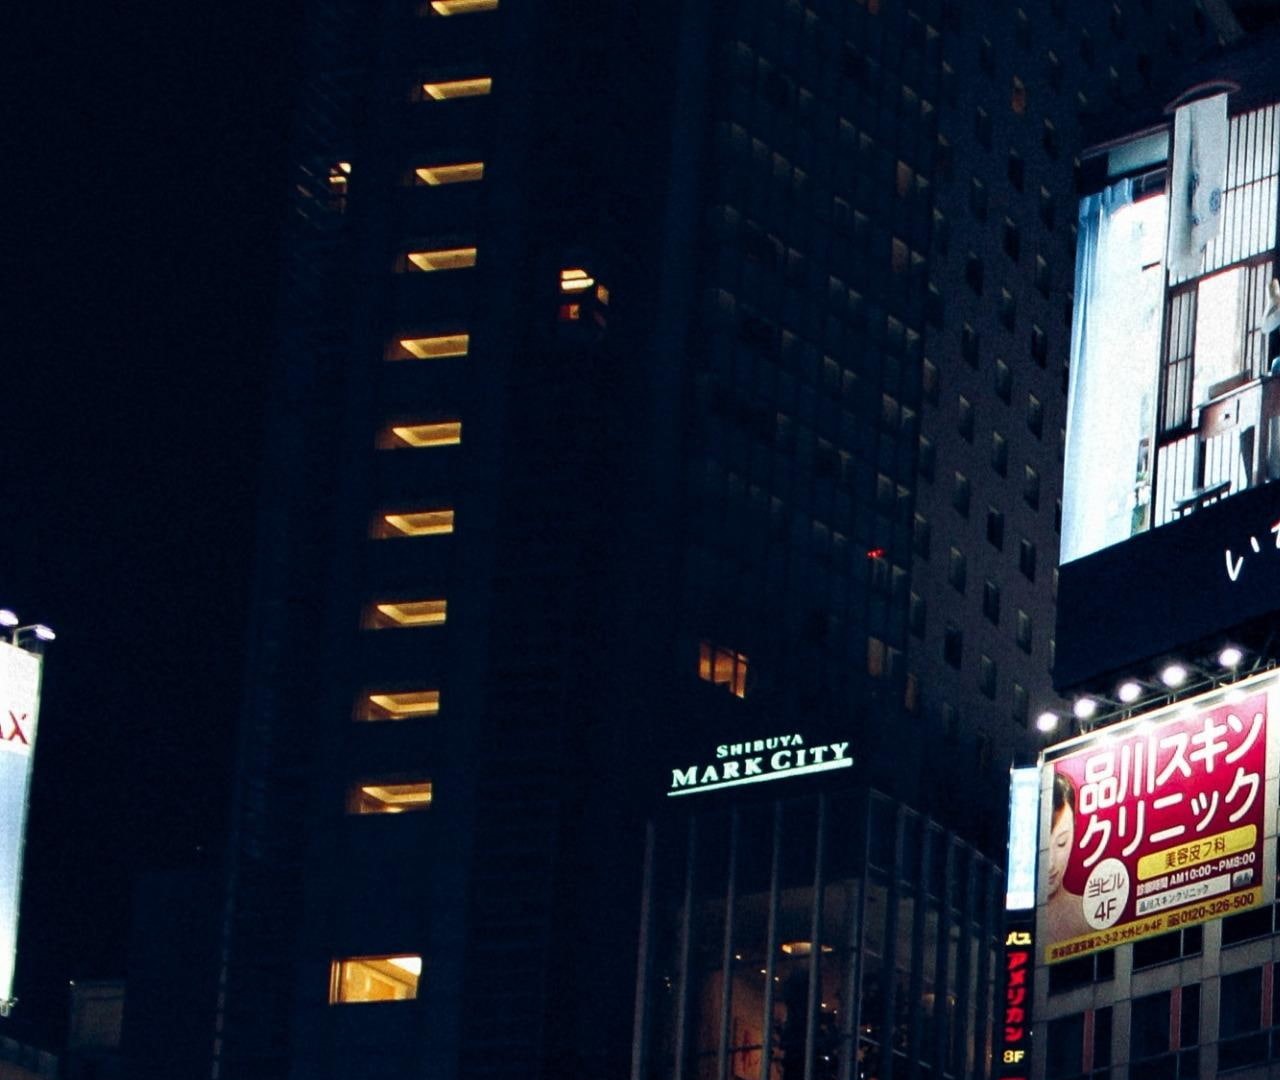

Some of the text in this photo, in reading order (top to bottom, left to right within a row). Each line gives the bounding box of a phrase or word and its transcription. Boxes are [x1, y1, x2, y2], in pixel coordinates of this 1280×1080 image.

[716, 734, 803, 759] SHIBUYA
[671, 742, 849, 788] MARK CITY
[1079, 713, 1264, 815] 品川スキン
[1079, 767, 1260, 868] クリニック
[1088, 872, 1125, 899] 当ビル
[1094, 898, 1117, 921] 4F
[1180, 892, 1255, 923] 0120-326-500
[1003, 1050, 1025, 1064] 8F
